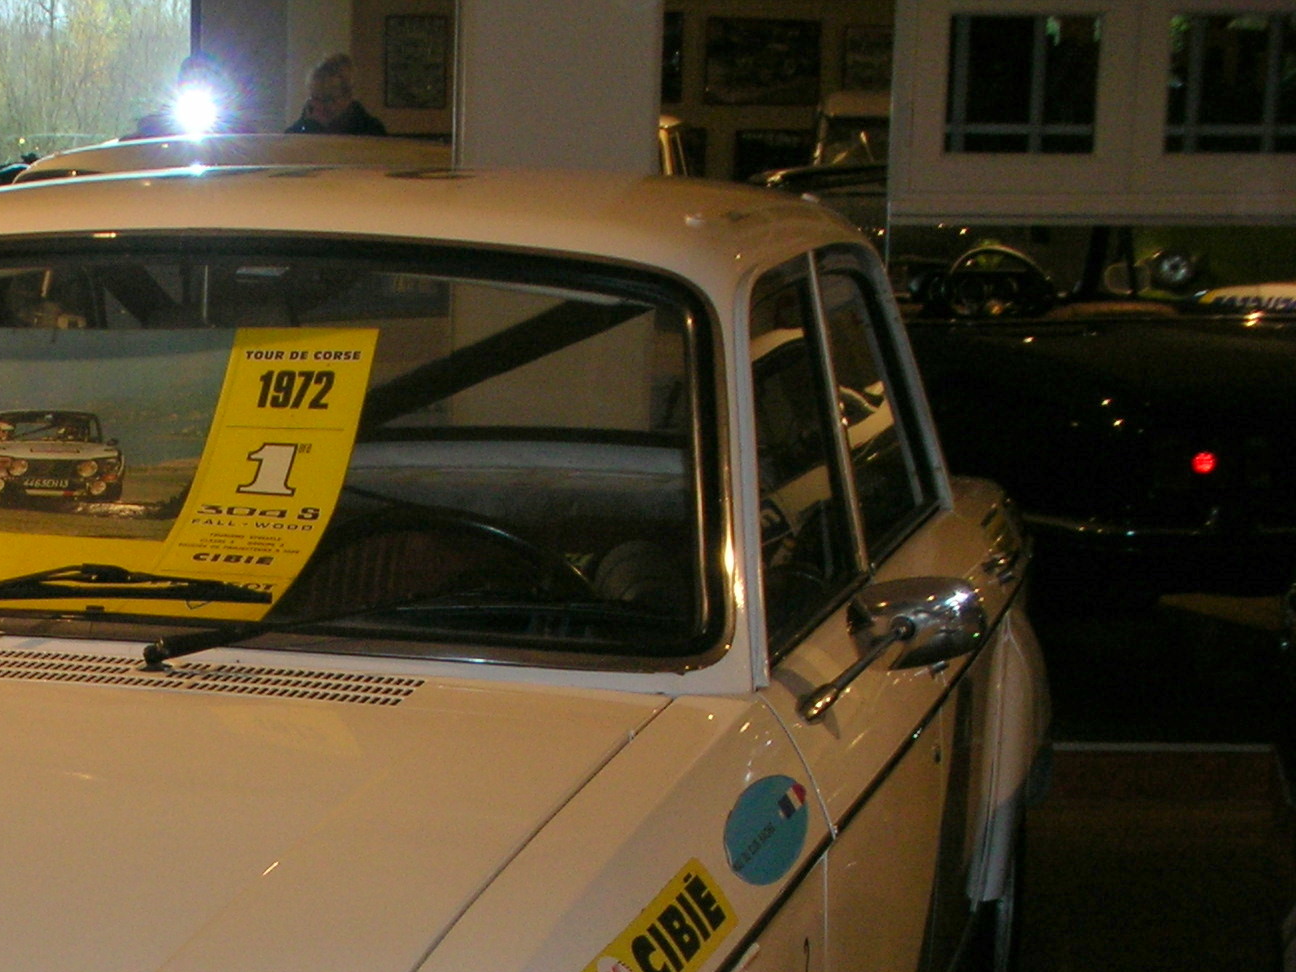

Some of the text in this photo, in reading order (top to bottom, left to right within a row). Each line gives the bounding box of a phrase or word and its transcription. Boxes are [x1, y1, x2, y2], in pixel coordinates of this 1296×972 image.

[245, 350, 362, 360] TOUR DE CORSE
[257, 370, 335, 410] 1972
[196, 503, 321, 521] 304 S
[191, 518, 237, 527] FALL
[255, 521, 314, 531] WOOD
